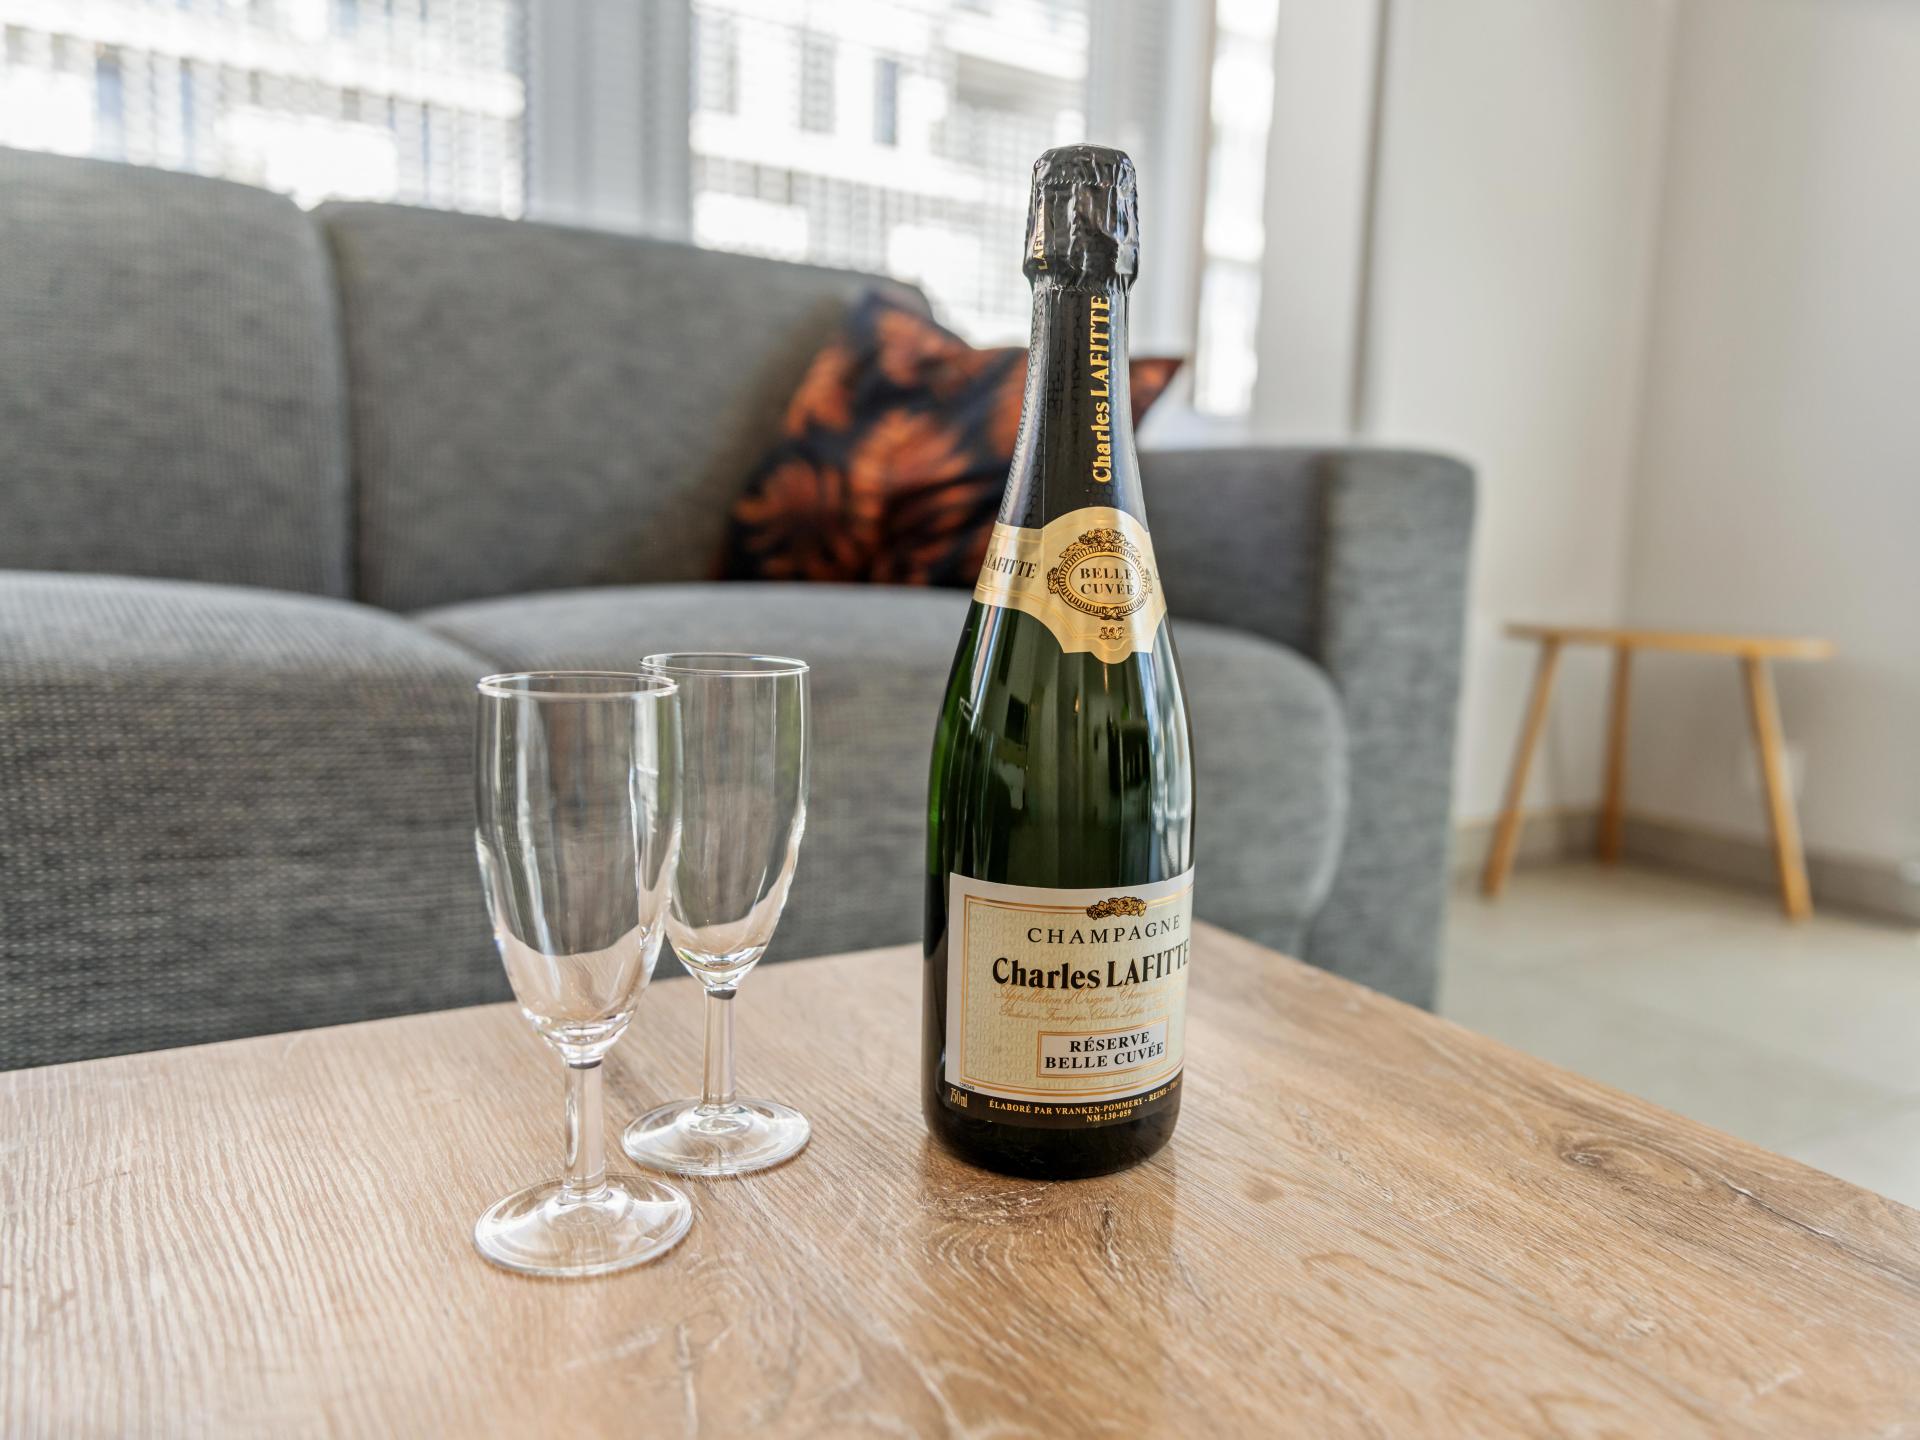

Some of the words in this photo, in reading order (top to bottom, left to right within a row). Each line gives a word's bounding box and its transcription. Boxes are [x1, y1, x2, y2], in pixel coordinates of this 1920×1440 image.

[1090, 296, 1111, 397] LAFITTE
[1091, 402, 1112, 483] Charles
[1080, 567, 1133, 580] BELLE
[1081, 581, 1135, 595] CUVÉE
[1027, 914, 1180, 944] CHAMPAGNE
[993, 957, 1100, 989] Charles
[1106, 938, 1188, 987] LAFITTE
[1045, 1054, 1108, 1069] BELLE
[1114, 1042, 1164, 1066] CUVÉE
[1069, 1031, 1150, 1053] RÉSERVE
[950, 1087, 968, 1108] 750ml
[989, 1099, 1031, 1113] ÉLABORÉ
[1034, 1106, 1052, 1115] PAR
[1055, 1098, 1143, 1115] VRANKEN-POMMERY
[1148, 1087, 1167, 1101] REIMS
